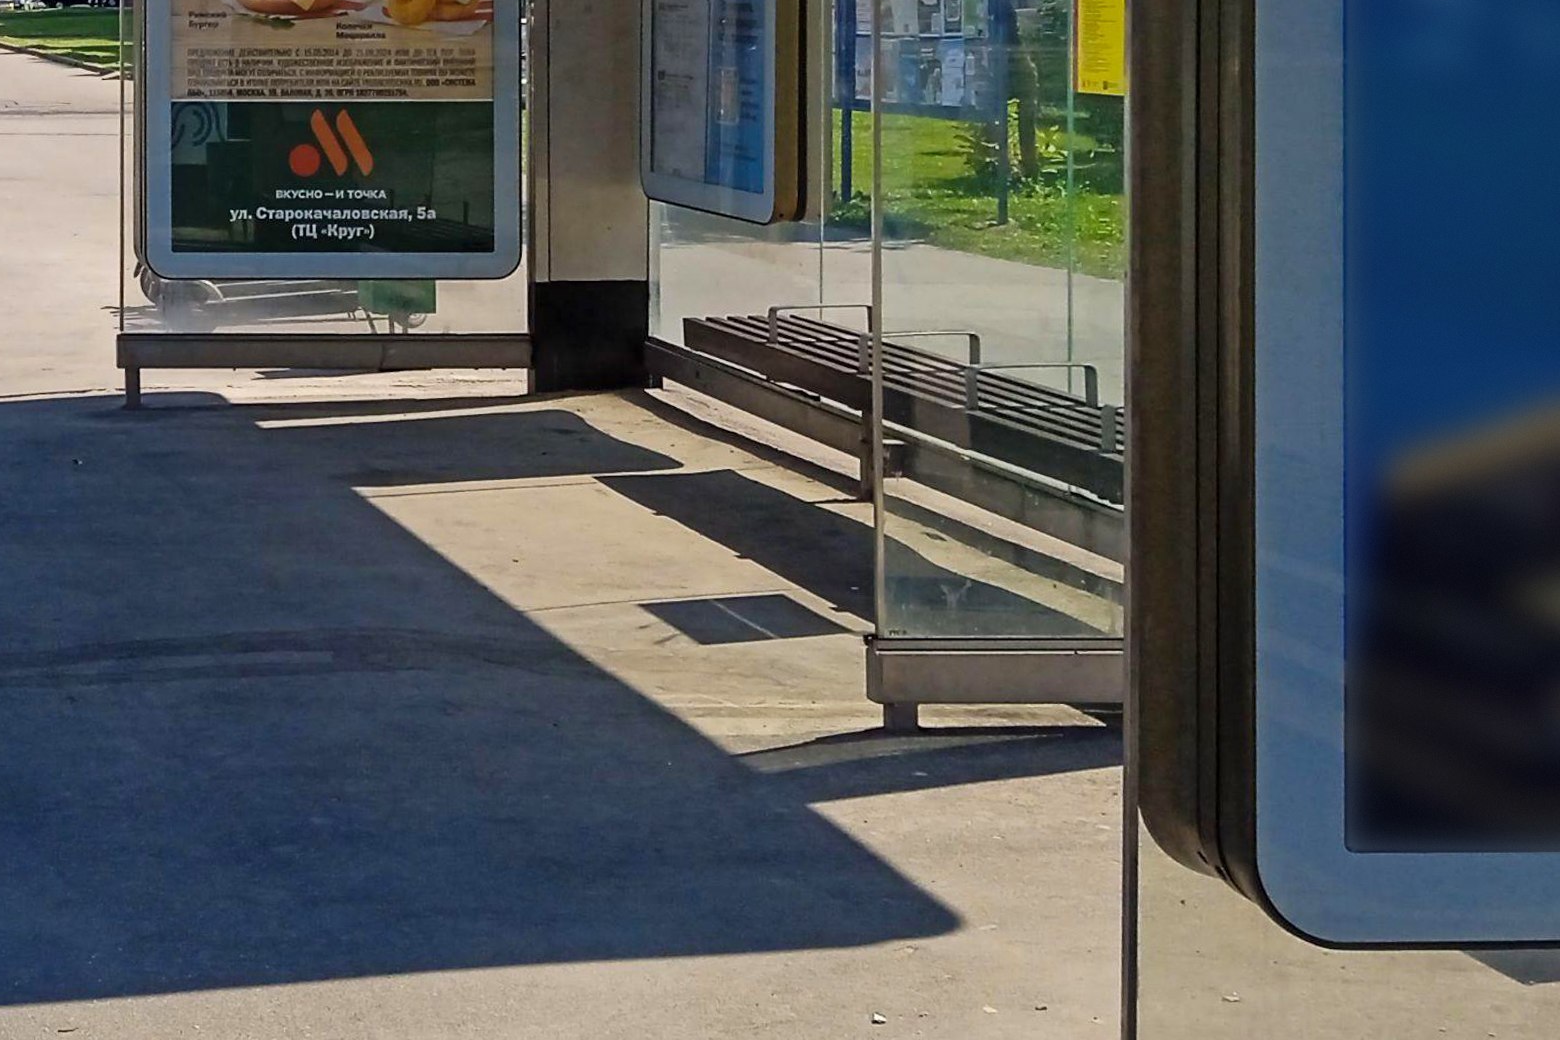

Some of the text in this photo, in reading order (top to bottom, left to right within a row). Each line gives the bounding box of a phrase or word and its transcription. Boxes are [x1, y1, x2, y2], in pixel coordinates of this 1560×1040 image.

[275, 190, 323, 199] ВКУСНО
[335, 190, 344, 199] И
[347, 190, 387, 199] ТОЧКА
[229, 207, 437, 222] ул. Старокачаловская, 5а
[291, 224, 375, 239] (ТЦ «Круг»)
